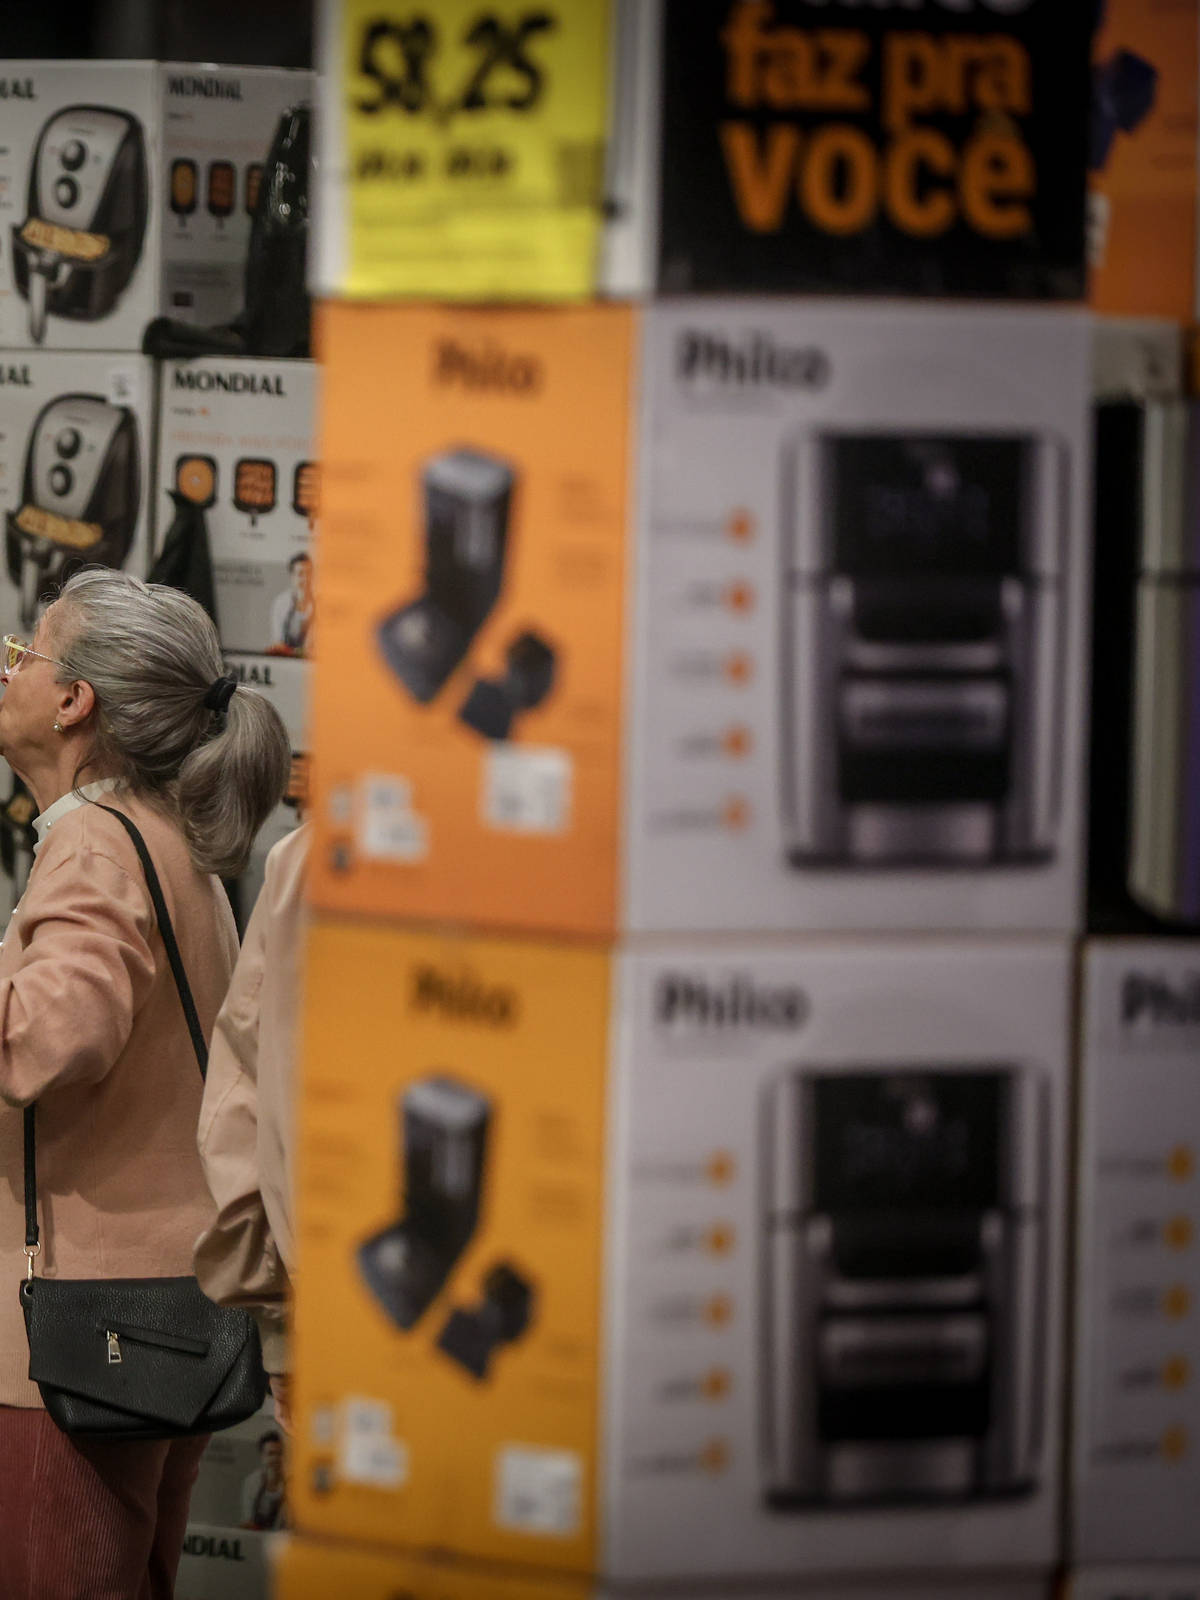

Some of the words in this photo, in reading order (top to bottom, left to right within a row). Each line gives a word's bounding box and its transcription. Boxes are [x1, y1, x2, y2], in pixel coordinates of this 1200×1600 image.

[720, 0, 872, 110] faz
[884, 30, 1033, 137] pra
[719, 110, 1037, 240] você
[174, 369, 287, 397] MONDIAL
[675, 328, 830, 393] Philco
